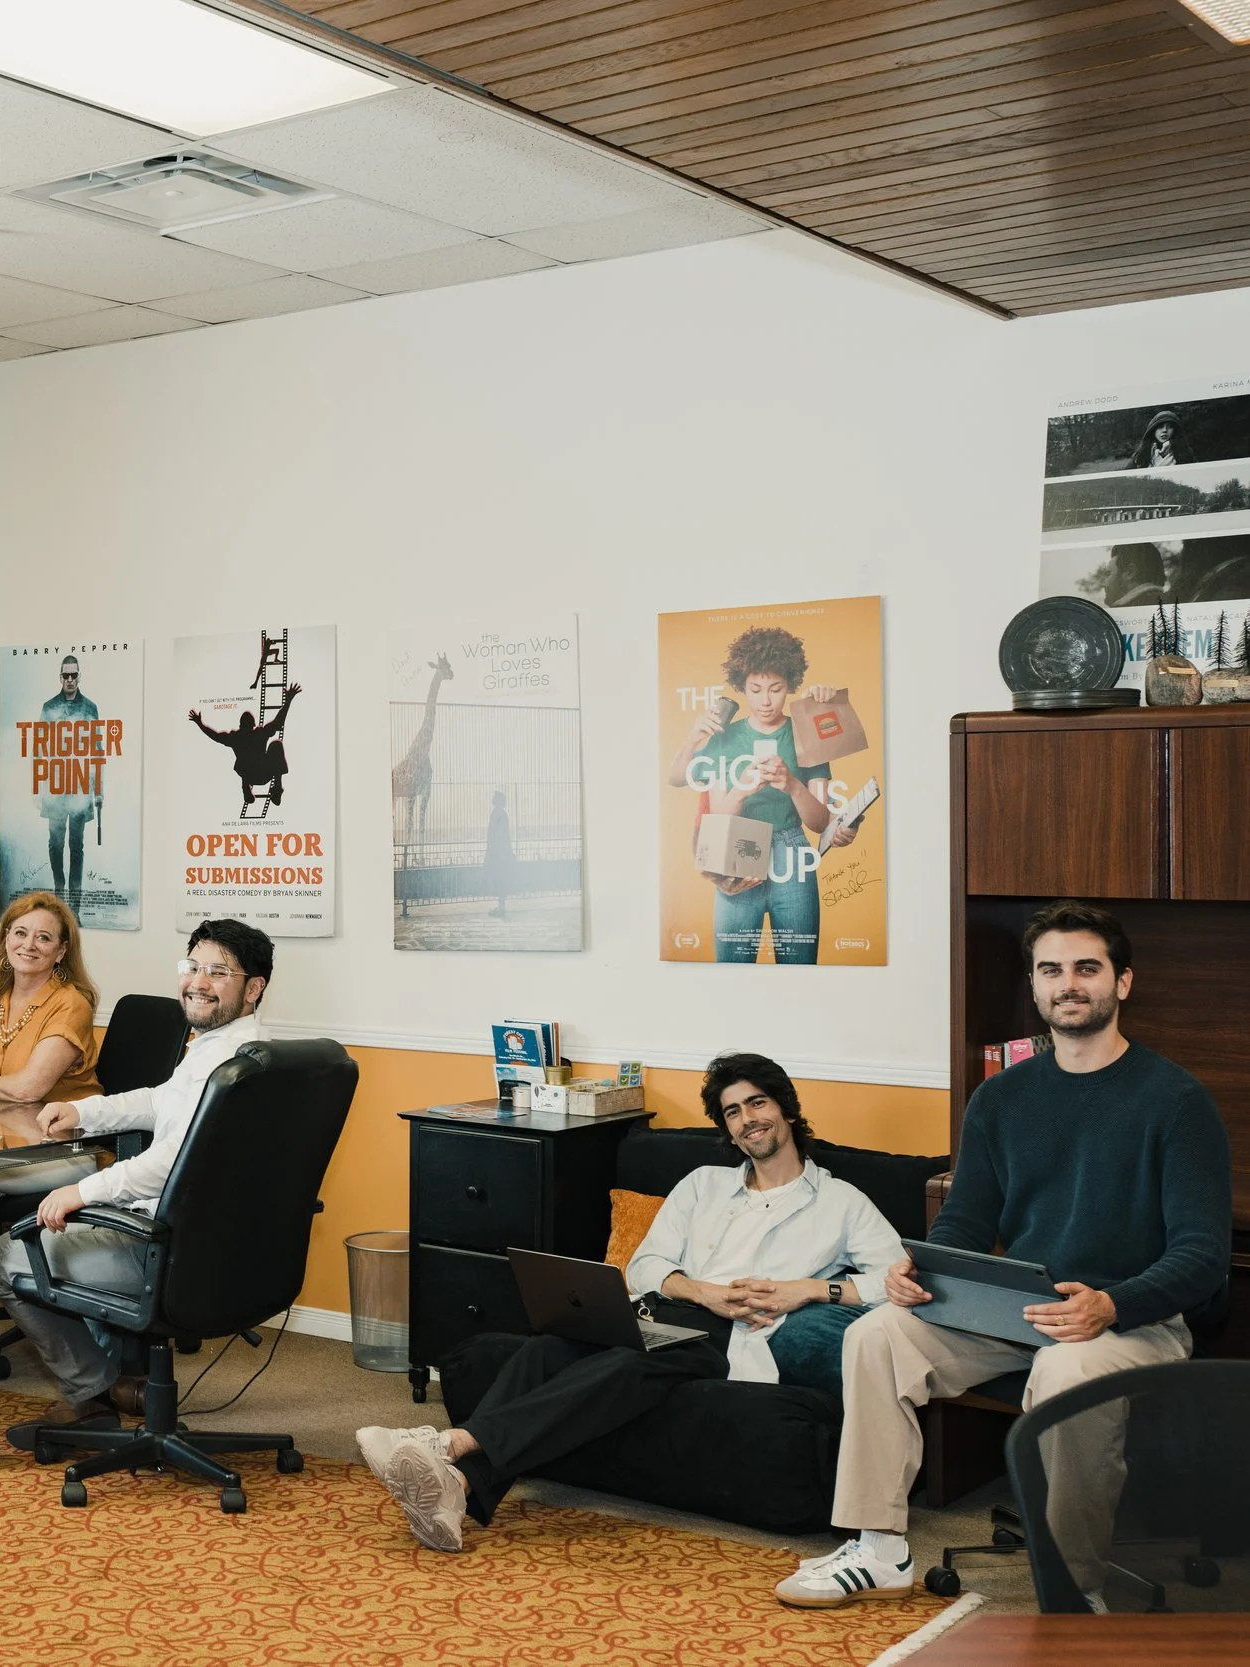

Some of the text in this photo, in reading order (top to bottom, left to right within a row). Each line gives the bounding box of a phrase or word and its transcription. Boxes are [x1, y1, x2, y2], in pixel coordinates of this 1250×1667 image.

[1213, 380, 1244, 390] KARINA
[1057, 395, 1118, 408] ANDREW DODD
[776, 608, 825, 618] CONVENIENCE
[462, 636, 570, 658] Woman Who
[481, 633, 500, 643] the
[12, 644, 128, 656] BARRY PEPPER
[492, 657, 541, 673] Loves
[483, 672, 550, 690] Giraffes
[676, 685, 725, 710] THE
[16, 720, 123, 757] TRIGGER
[33, 758, 106, 795] POINT
[685, 754, 761, 792] GIG
[816, 780, 849, 814] IS
[186, 833, 323, 857] OPEN FOR
[767, 846, 822, 883] UP
[185, 867, 323, 884] SUBMISSIONS
